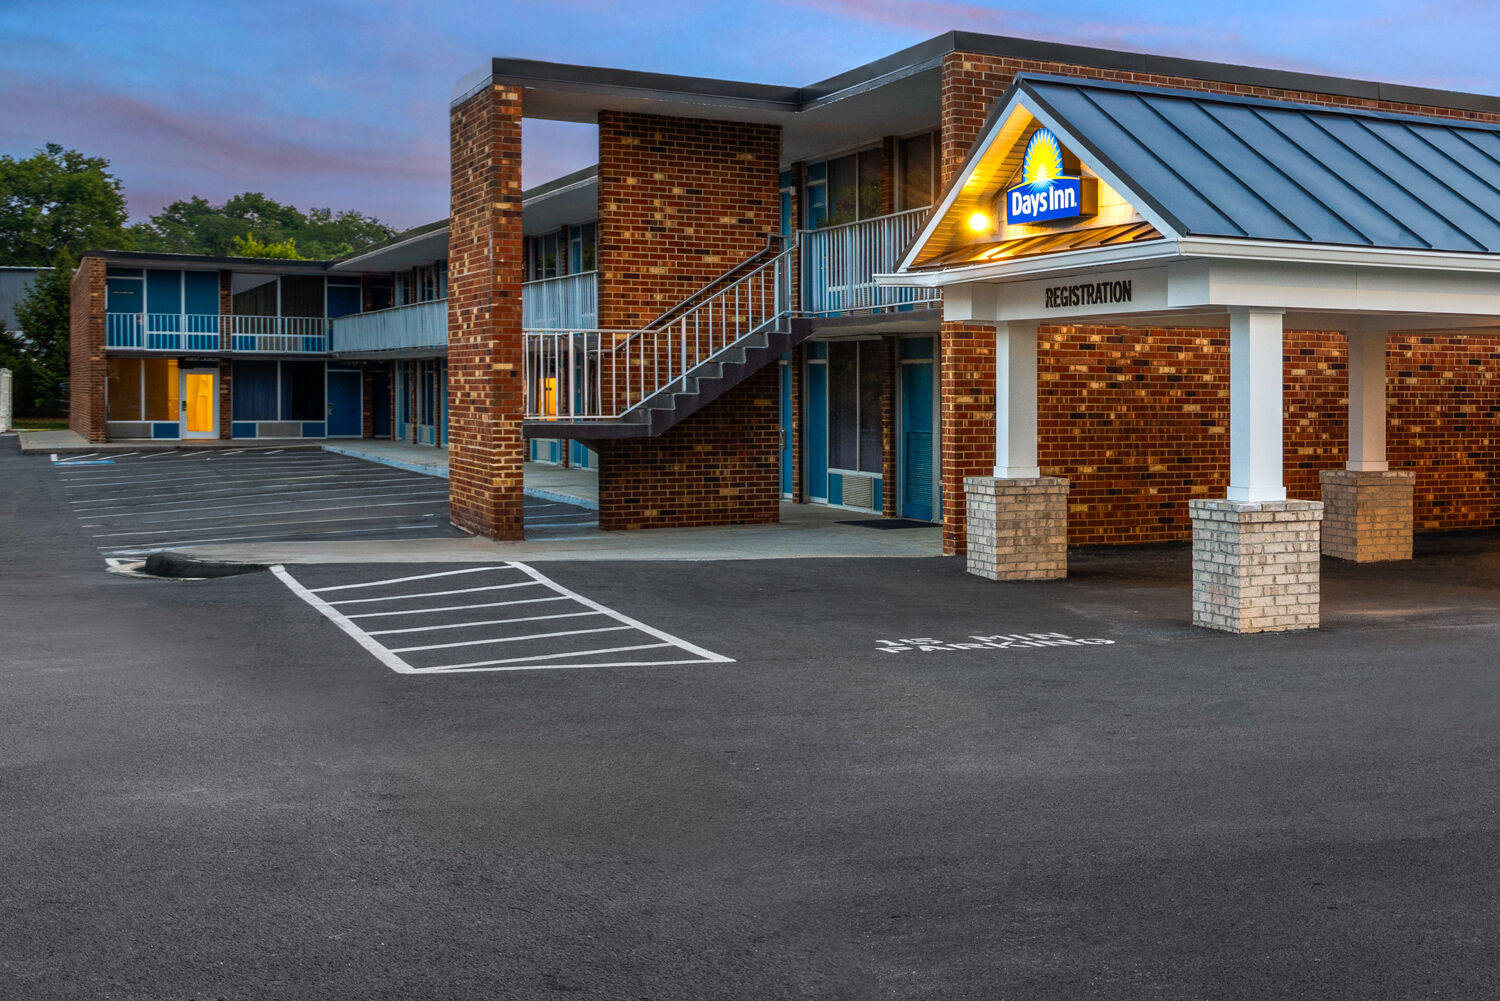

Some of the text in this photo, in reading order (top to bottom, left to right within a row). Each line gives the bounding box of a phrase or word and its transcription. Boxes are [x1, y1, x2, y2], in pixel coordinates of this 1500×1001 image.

[1012, 186, 1075, 217] Days Inn
[1045, 280, 1133, 309] REGISTRATION
[875, 632, 1073, 646] 15 MIN
[875, 638, 1116, 653] PARKING
